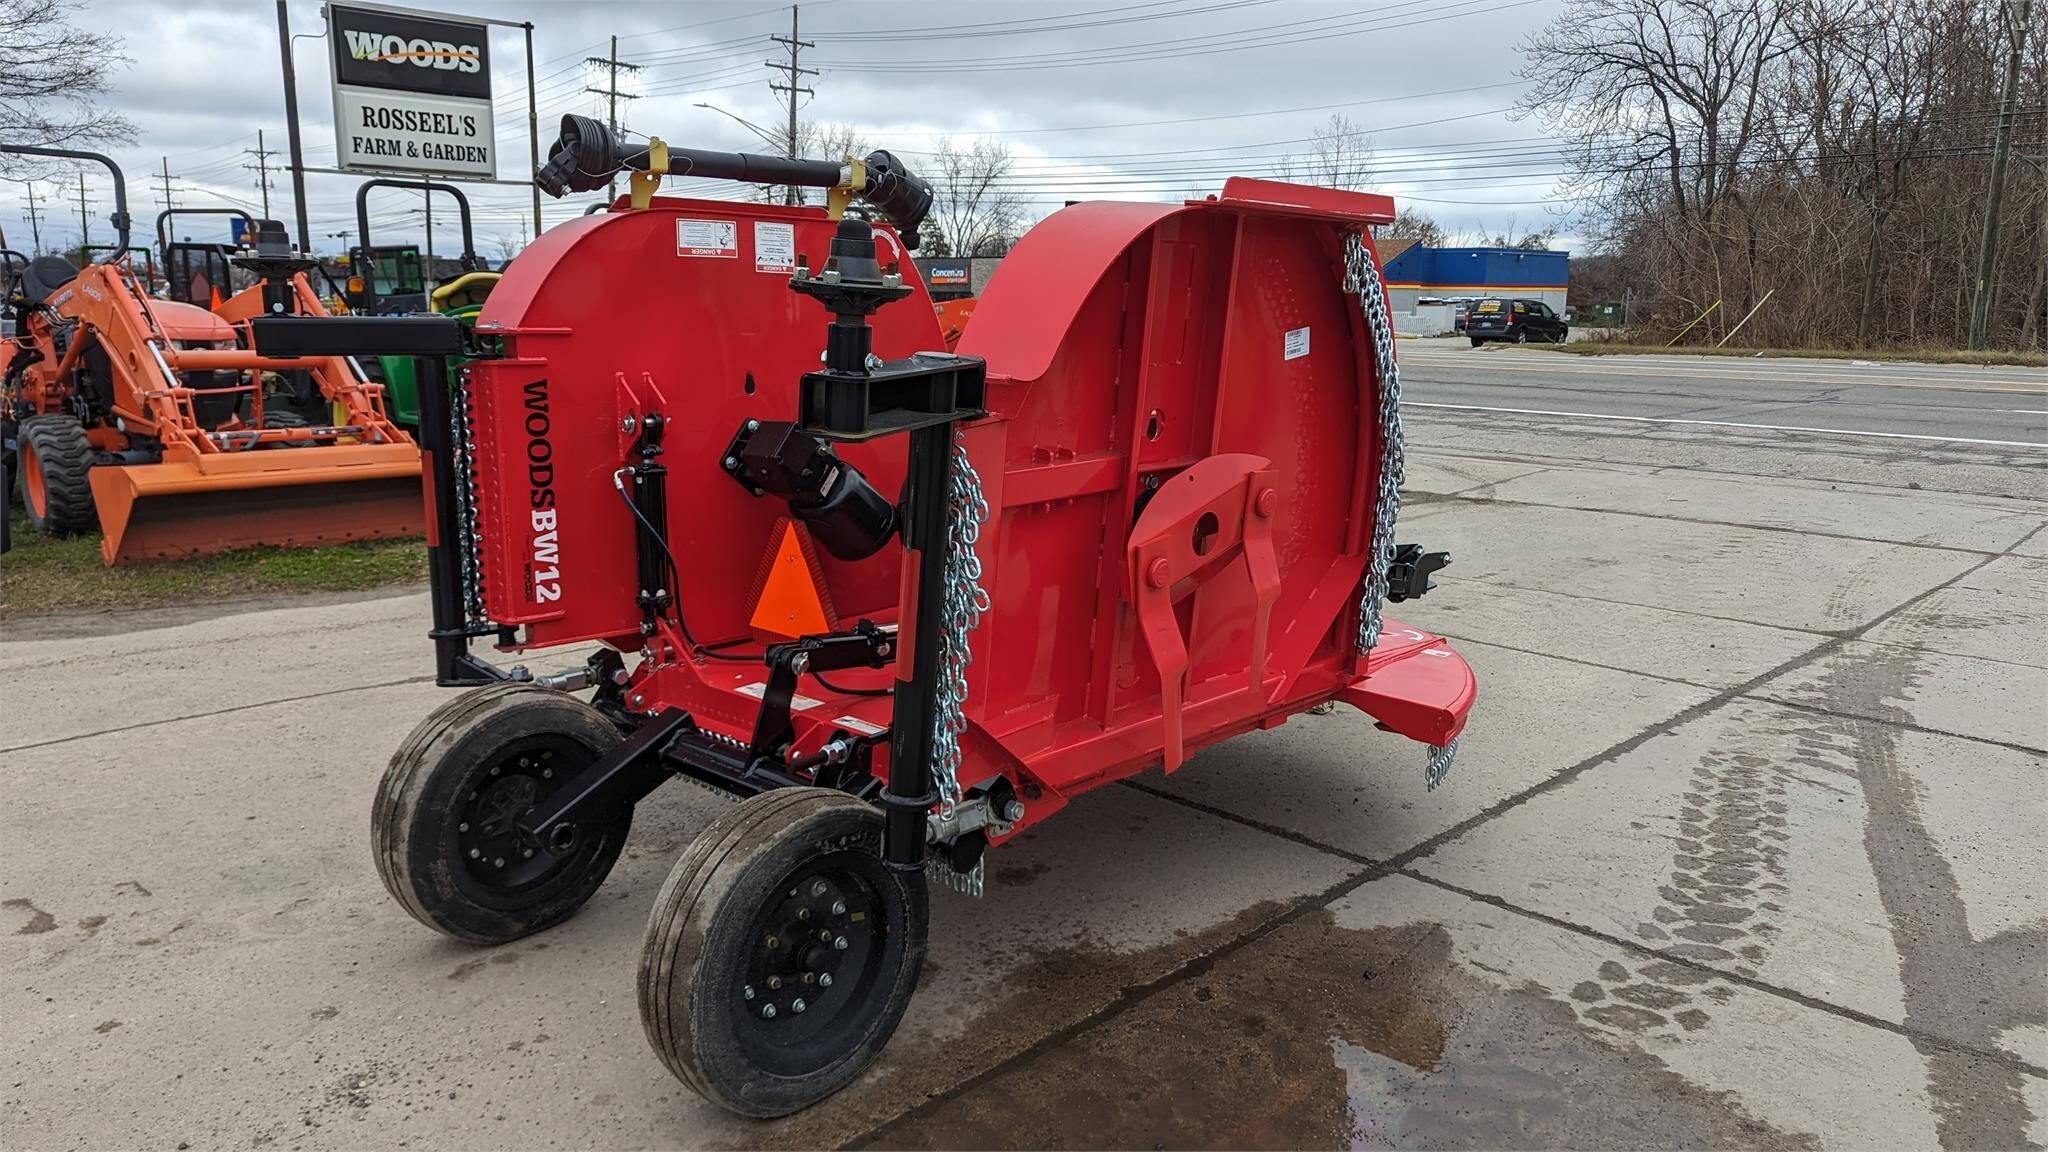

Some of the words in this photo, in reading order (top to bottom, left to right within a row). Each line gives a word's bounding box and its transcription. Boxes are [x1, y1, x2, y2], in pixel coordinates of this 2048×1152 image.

[344, 30, 481, 73] WOODS
[361, 106, 476, 137] ROSSEEL'S
[352, 136, 401, 157] FARM
[406, 141, 420, 158] &
[422, 142, 487, 163] GARDEN
[691, 248, 716, 256] DANGER
[523, 379, 556, 509] WOODS
[531, 508, 562, 604] BW12
